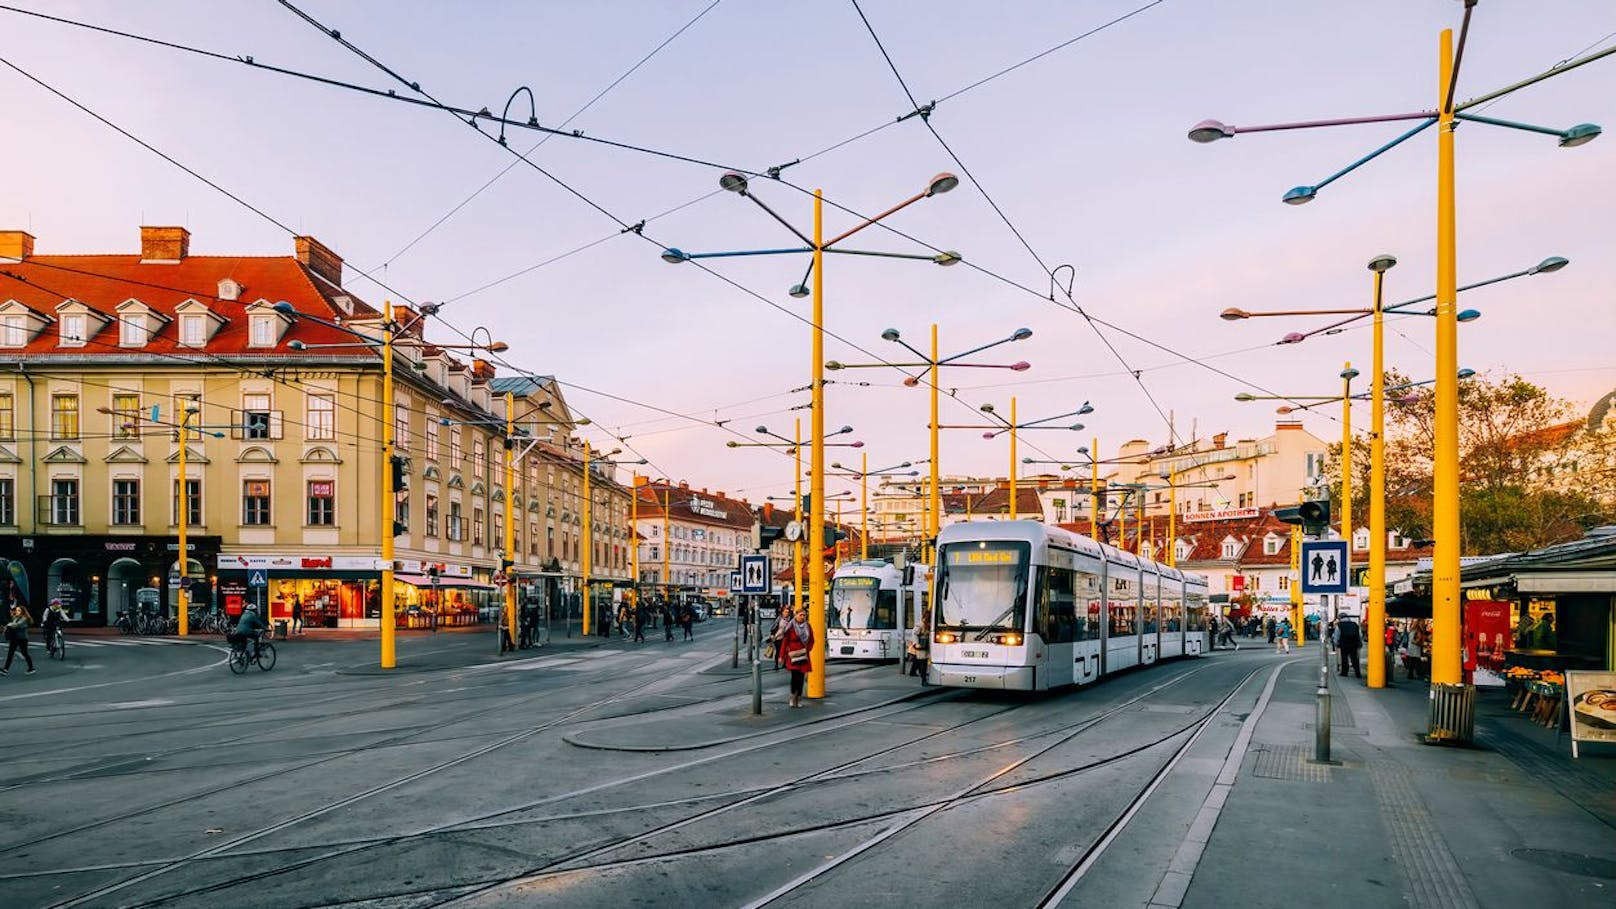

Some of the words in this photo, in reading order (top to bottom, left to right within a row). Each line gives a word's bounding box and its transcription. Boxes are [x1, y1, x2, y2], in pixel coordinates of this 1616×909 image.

[1185, 511, 1216, 520] SONNEN
[1217, 509, 1257, 518] APOTHEKE
[964, 675, 977, 683] 217
